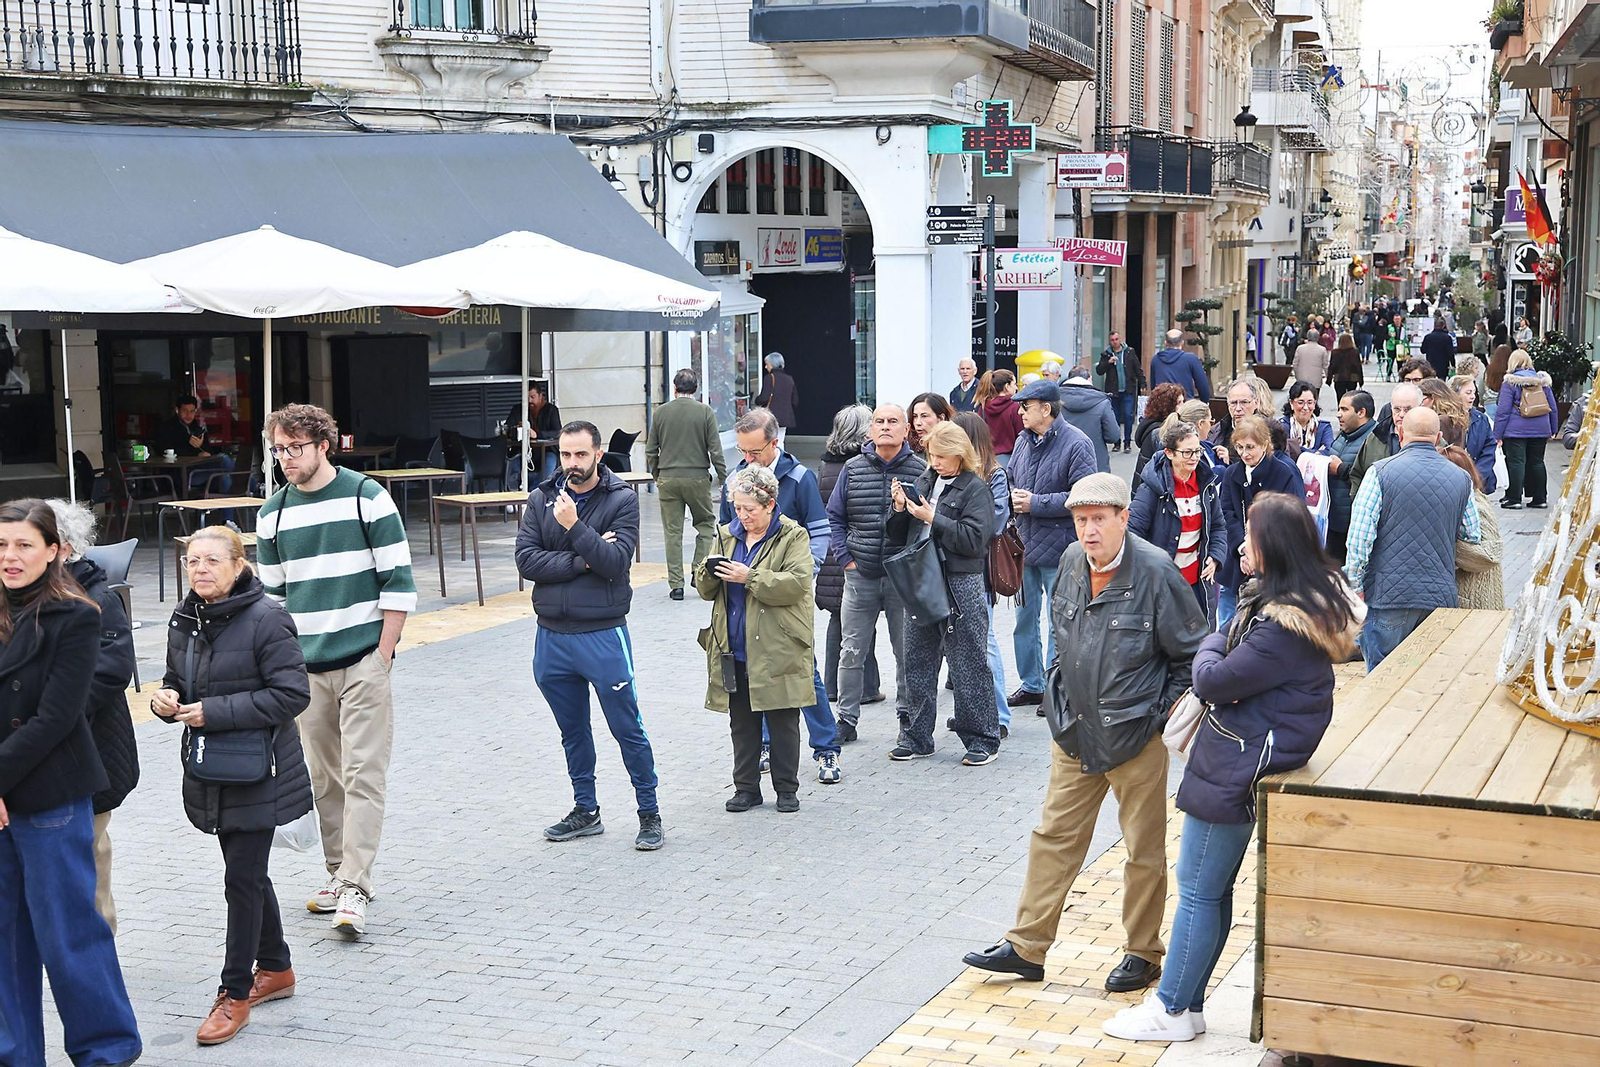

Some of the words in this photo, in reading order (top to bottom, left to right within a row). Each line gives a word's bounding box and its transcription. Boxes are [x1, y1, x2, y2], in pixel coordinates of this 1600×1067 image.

[806, 236, 819, 256] AG
[1057, 238, 1122, 256] PELUQUERIA
[704, 253, 724, 264] ZAPATOS
[1012, 253, 1054, 264] Estética
